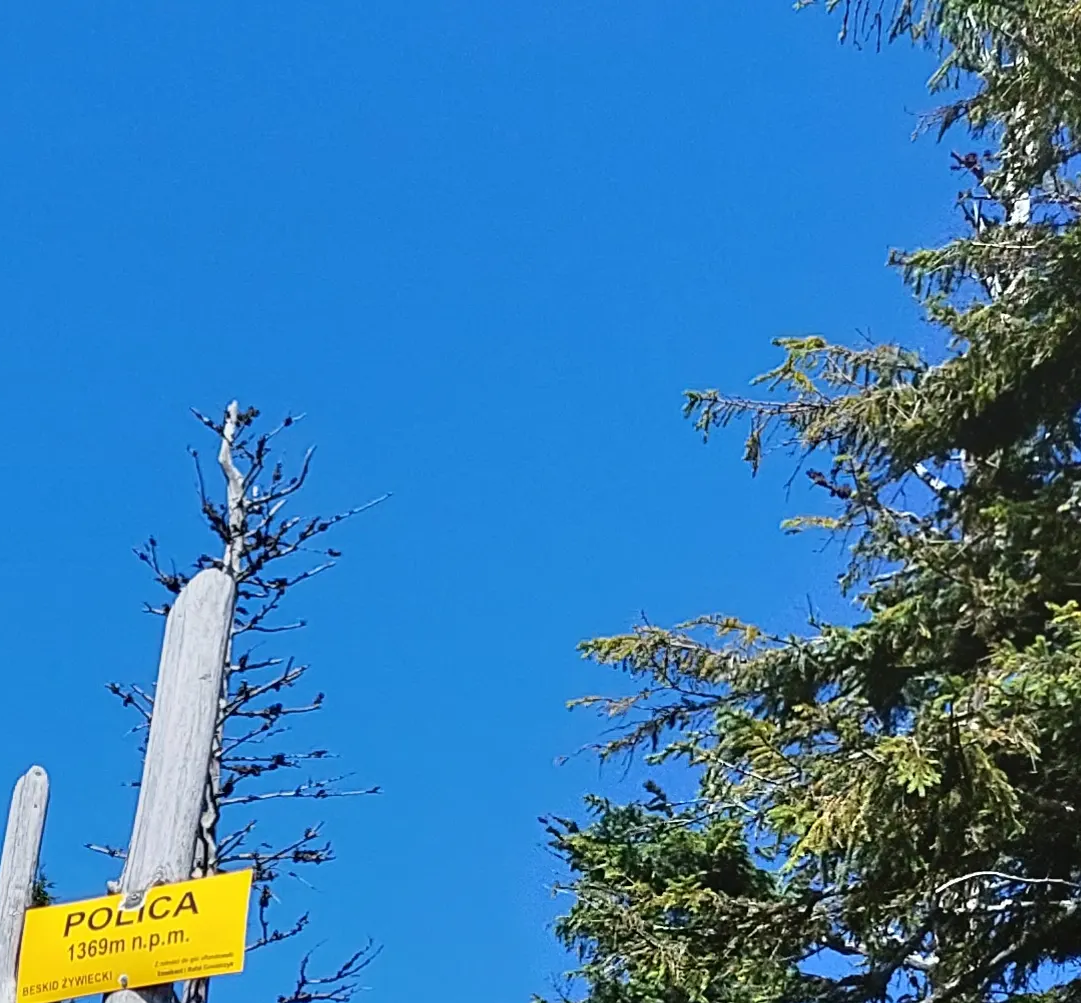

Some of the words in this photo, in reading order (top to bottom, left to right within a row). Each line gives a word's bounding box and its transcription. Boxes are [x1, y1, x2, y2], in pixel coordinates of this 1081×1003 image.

[63, 891, 199, 938] POLICA
[68, 938, 125, 962] 1369m
[132, 929, 190, 953] n.p.m.
[22, 981, 59, 997] BESKID
[61, 970, 113, 992] ŻYWIECKI
